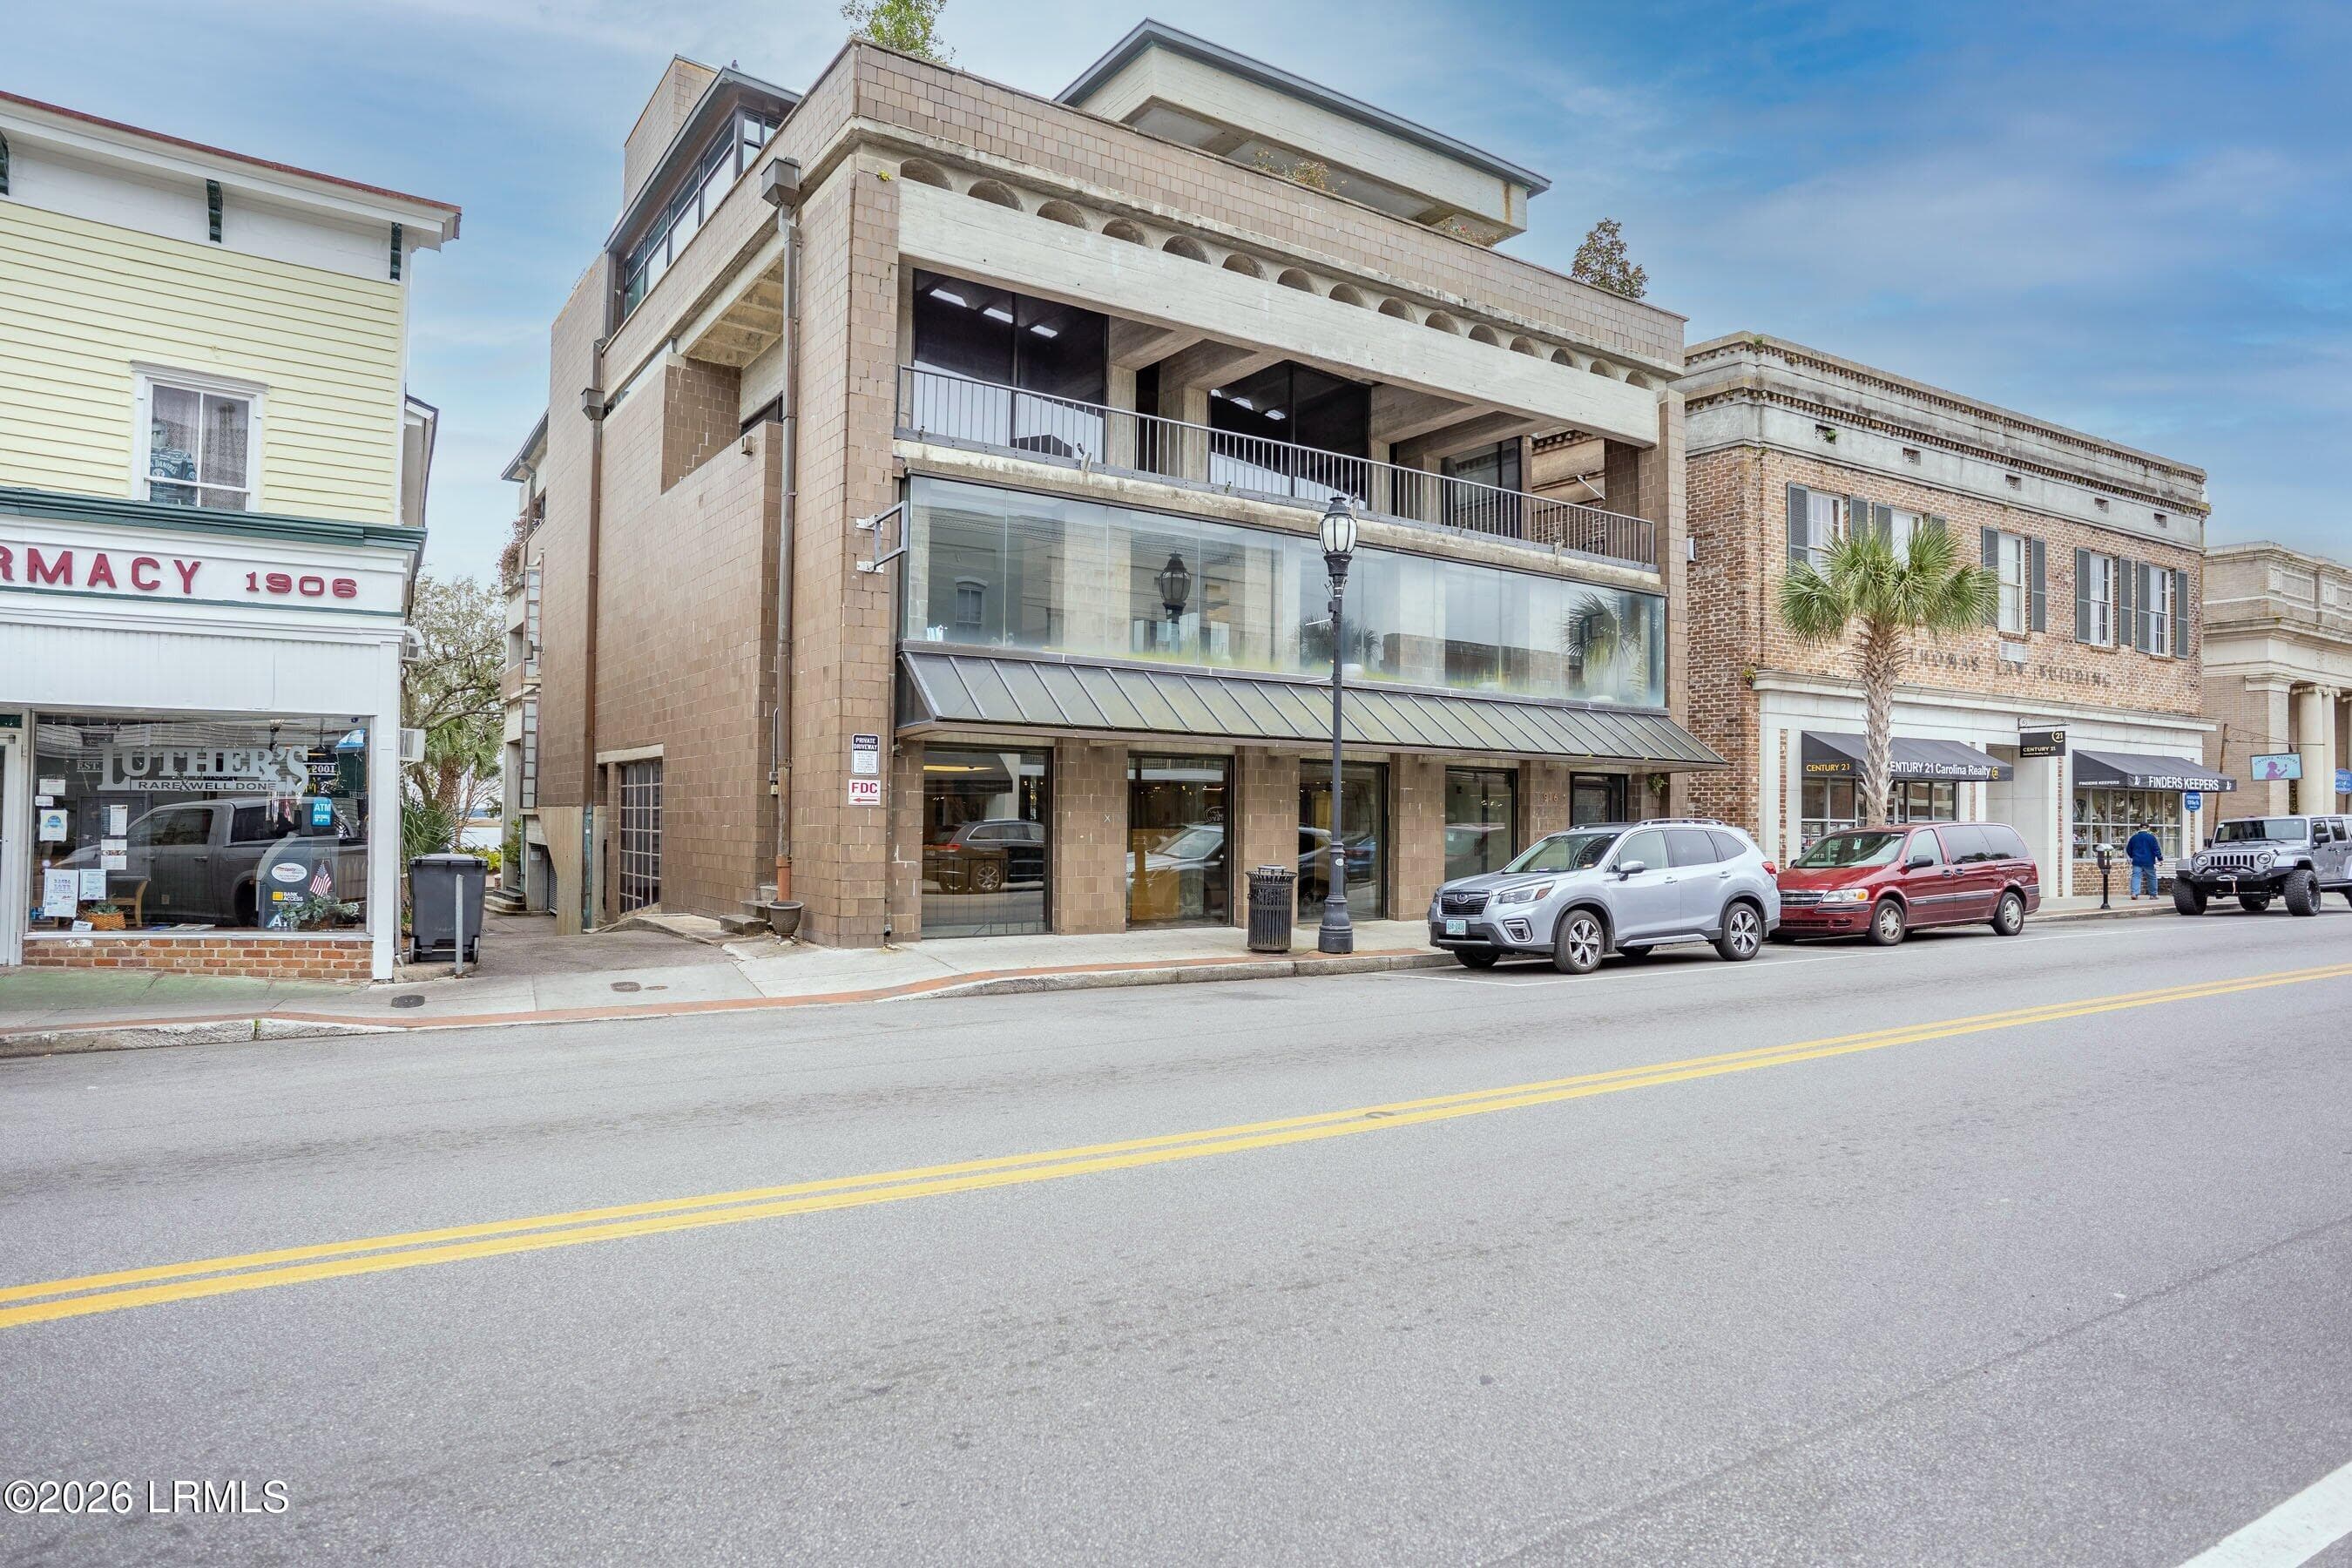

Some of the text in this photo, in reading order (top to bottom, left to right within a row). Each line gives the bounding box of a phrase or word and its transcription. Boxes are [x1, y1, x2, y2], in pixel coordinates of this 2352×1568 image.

[246, 571, 358, 598] 1906
[77, 761, 100, 770] EST.
[97, 743, 309, 799] LUTHER'S
[312, 765, 336, 774] 2001
[1806, 763, 1840, 772] CENTURY
[1889, 760, 1923, 774] ENTURY
[1924, 762, 1934, 774] 21
[1936, 763, 1967, 775] Carolina
[1969, 765, 1991, 778] Realty
[139, 781, 179, 790] RARE
[191, 781, 233, 790] WELL
[236, 781, 276, 791] DONE
[851, 782, 878, 794] FDC
[2148, 775, 2219, 791] FINDERS KEEPERS
[314, 803, 331, 812] ATM
